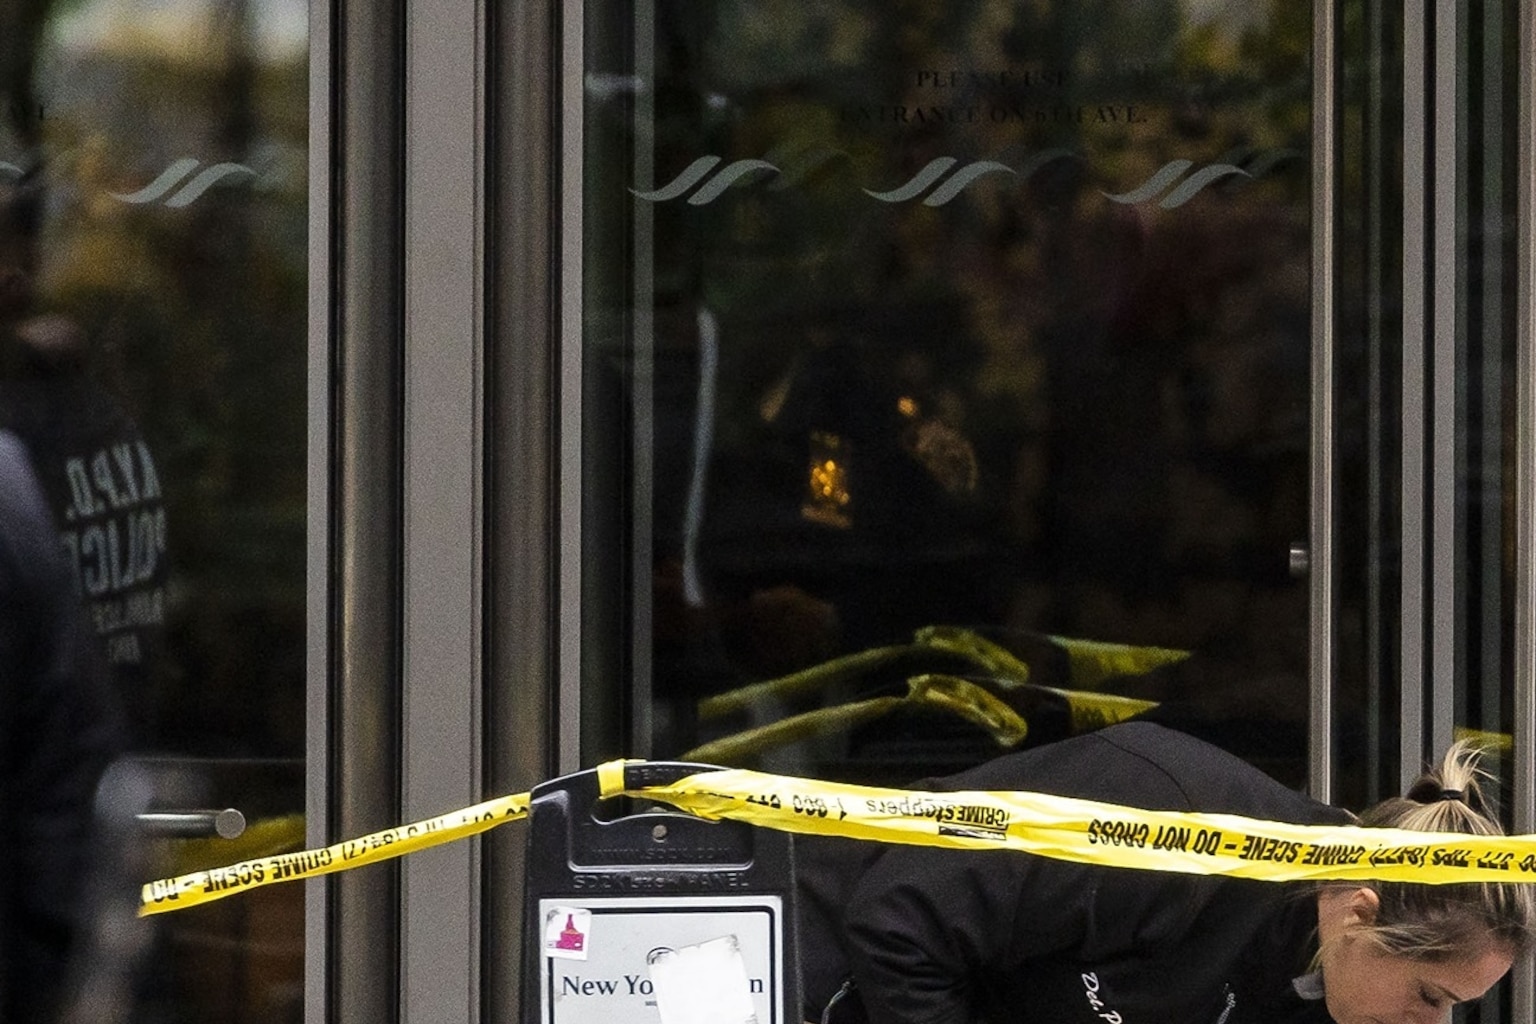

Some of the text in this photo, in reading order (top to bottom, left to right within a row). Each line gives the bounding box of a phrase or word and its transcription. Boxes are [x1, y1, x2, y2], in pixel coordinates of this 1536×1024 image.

[840, 106, 979, 123] ENTRANCE
[989, 106, 1024, 123] ON
[1087, 818, 1149, 849] CROSS
[1152, 826, 1191, 853] NOT
[1192, 829, 1222, 857] DO
[1239, 834, 1303, 863] SCENE
[1302, 843, 1366, 866] CRIME
[200, 861, 266, 893] SCENE
[561, 974, 654, 996] New Yo
